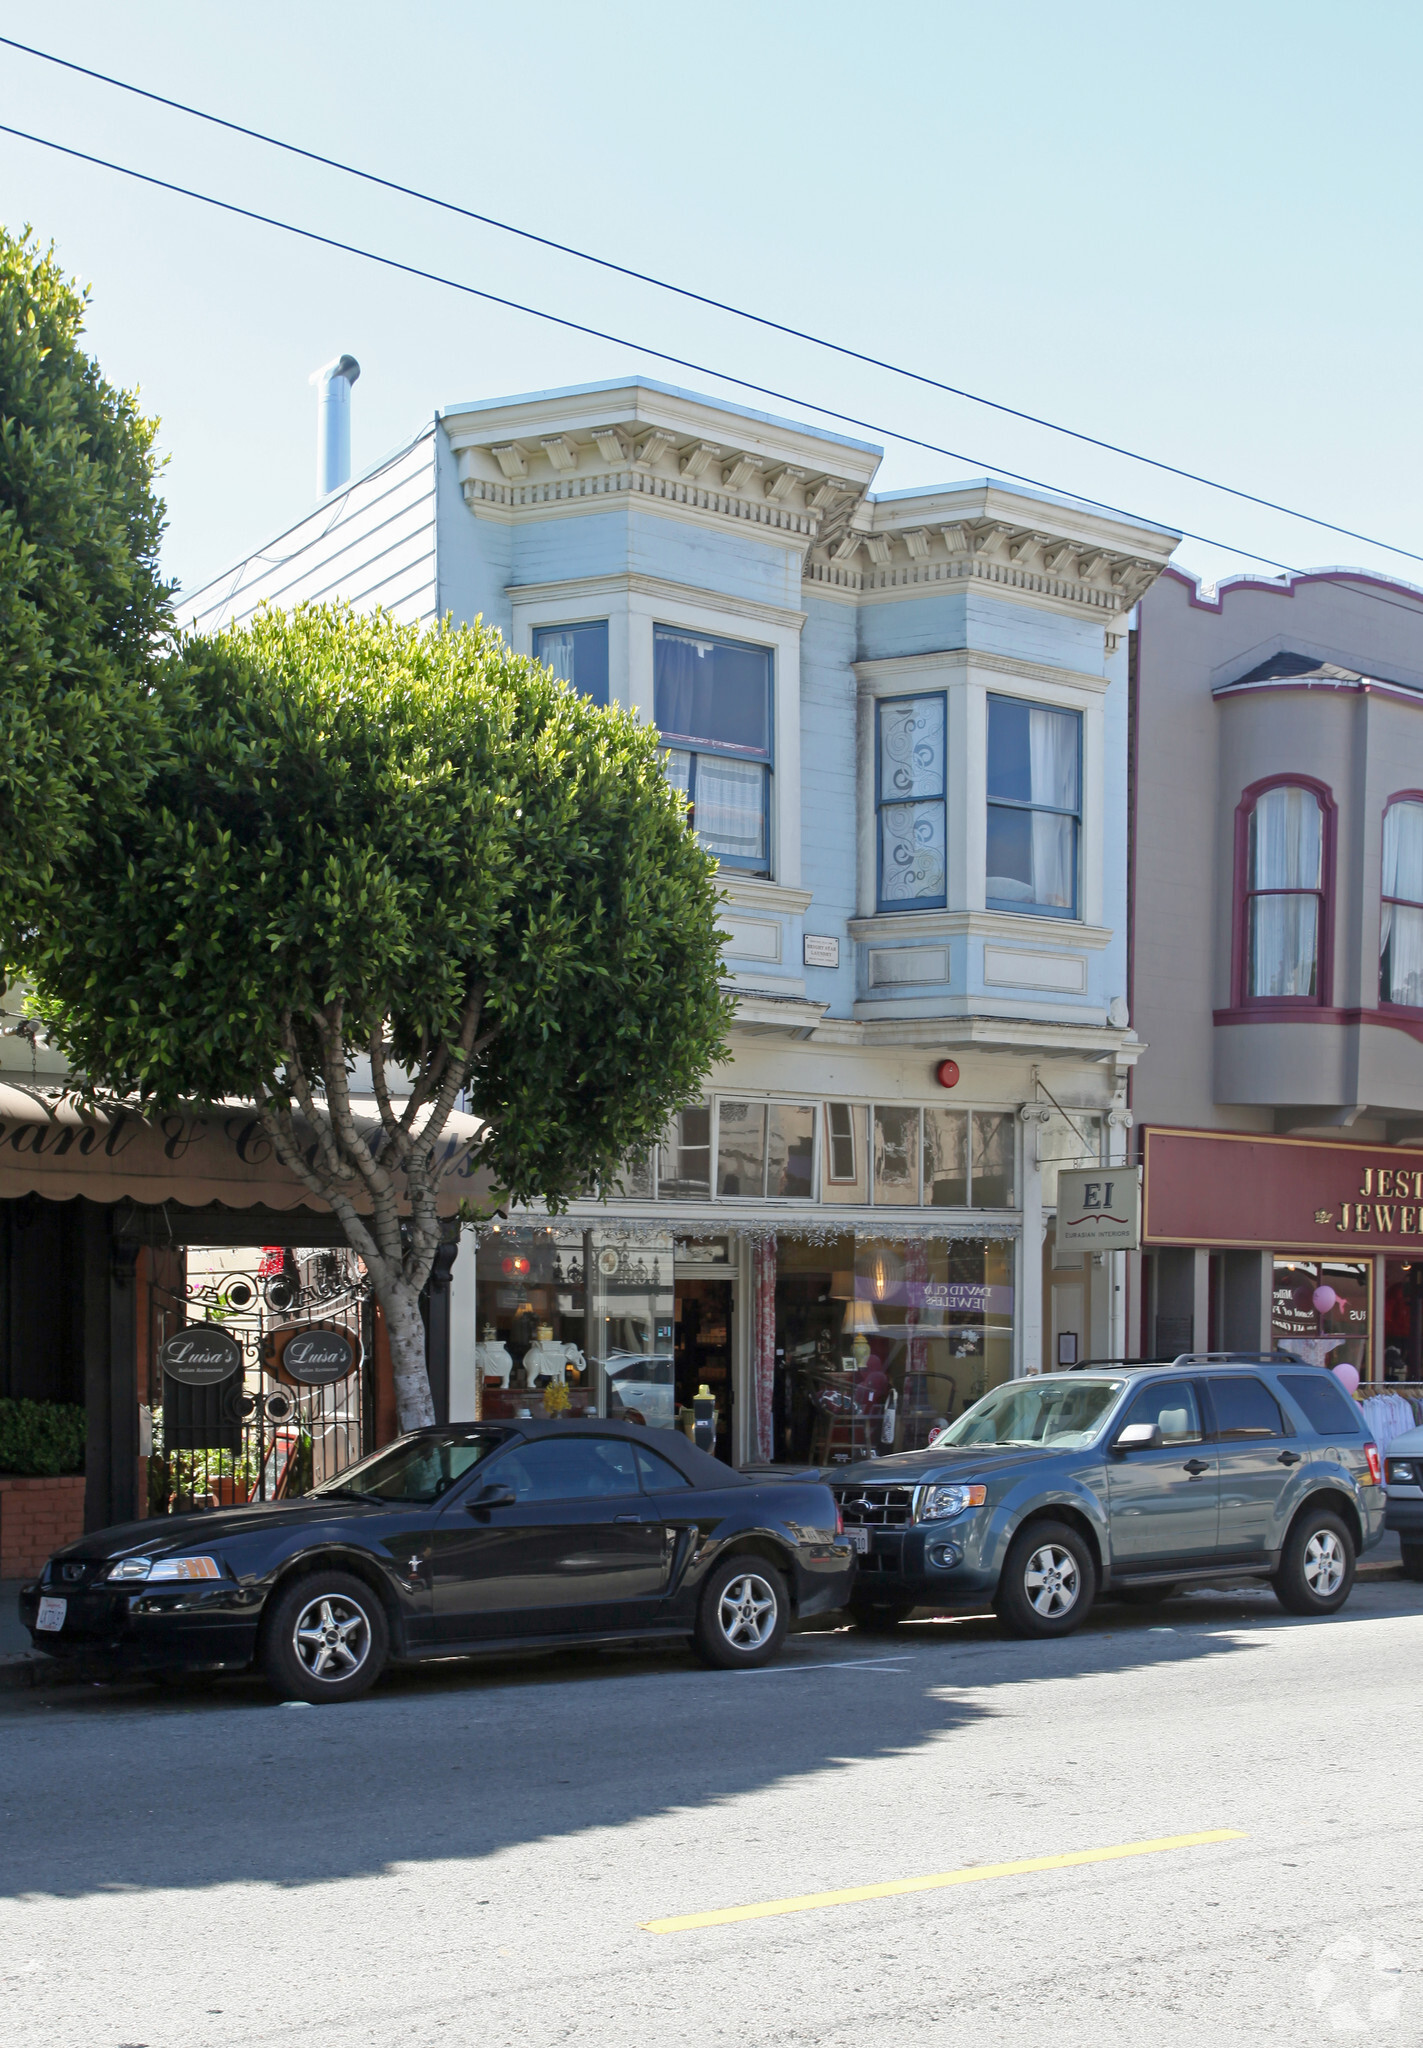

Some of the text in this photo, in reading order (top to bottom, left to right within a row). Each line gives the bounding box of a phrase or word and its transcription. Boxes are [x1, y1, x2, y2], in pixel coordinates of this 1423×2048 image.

[0, 1112, 138, 1157] ant
[161, 1115, 207, 1160] &
[1083, 1182, 1114, 1209] EI
[166, 1341, 234, 1364] Luisa's
[290, 1342, 348, 1364] Luisa's
